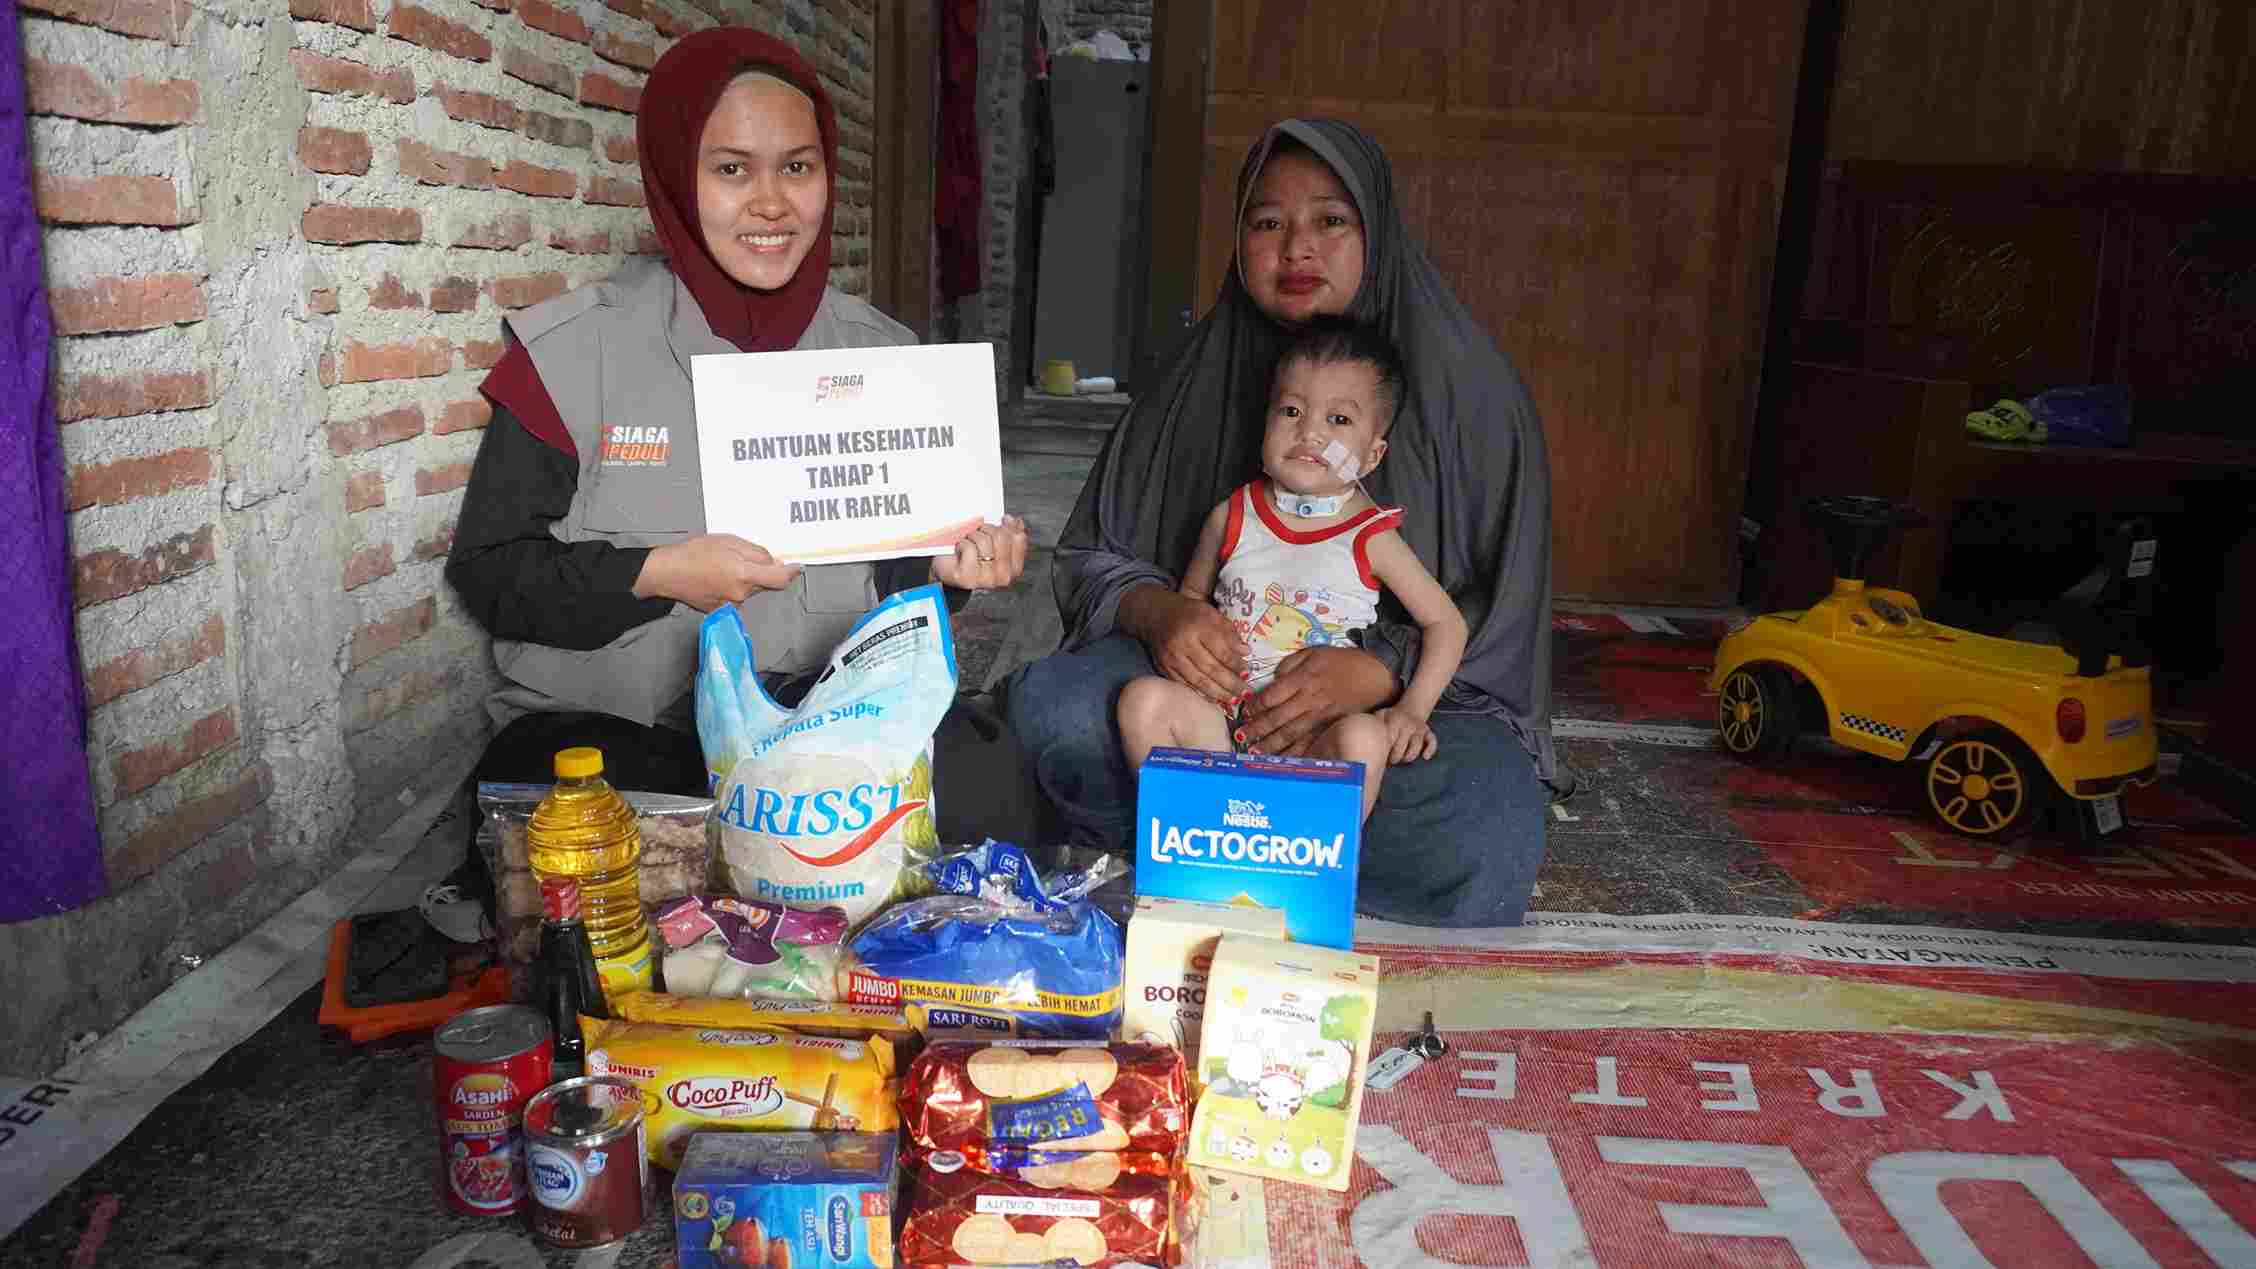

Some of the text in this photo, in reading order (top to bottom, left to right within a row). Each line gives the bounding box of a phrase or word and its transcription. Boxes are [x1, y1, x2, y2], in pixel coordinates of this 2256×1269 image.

[831, 375, 864, 387] SIAGA
[611, 426, 669, 443] SIAGA
[732, 425, 954, 461] BANTUAN KESEHATAN
[806, 462, 889, 489] TAHAP 1
[790, 493, 911, 524] ADIK RAFKA
[830, 702, 885, 722] Super
[1152, 817, 1344, 869] LACTOGROW
[759, 879, 865, 901] Premium
[852, 975, 897, 999] JUMBO
[901, 983, 957, 1001] KEMASAN
[1065, 998, 1102, 1014] HEMAT
[933, 1008, 967, 1026] SARI
[672, 1075, 777, 1107] Coco Puff
